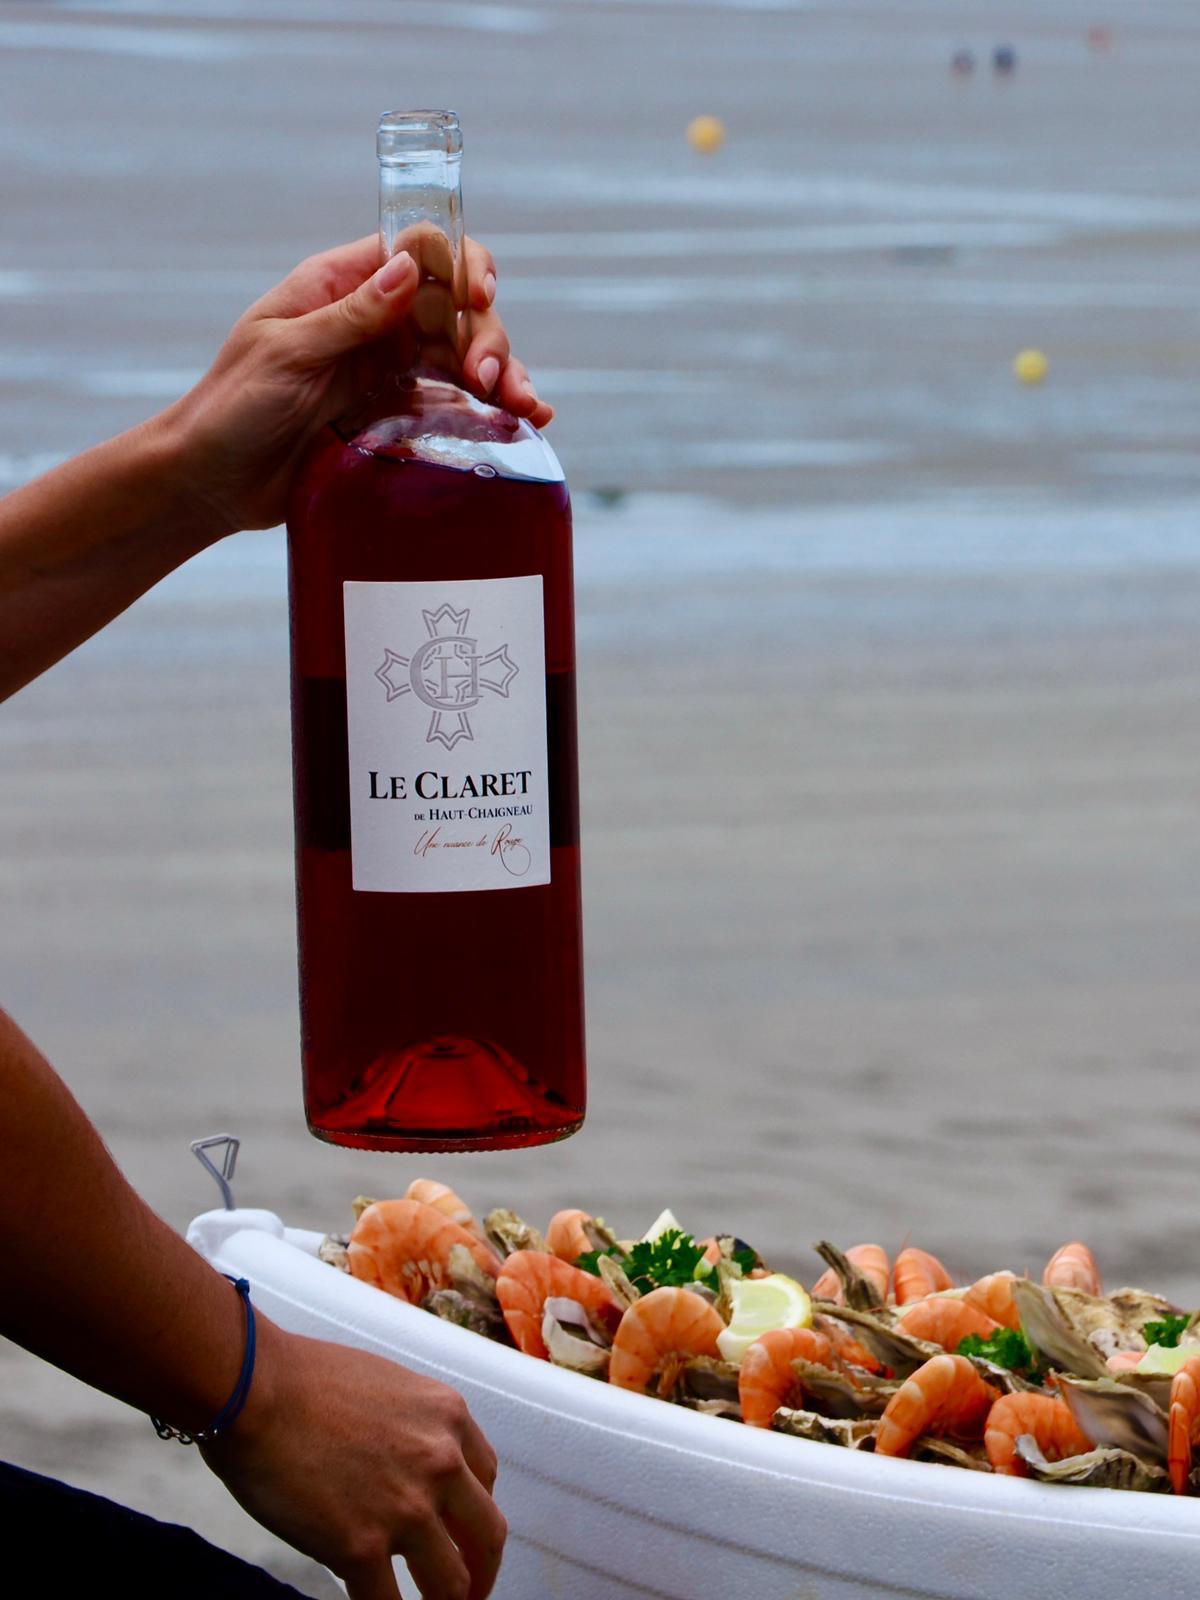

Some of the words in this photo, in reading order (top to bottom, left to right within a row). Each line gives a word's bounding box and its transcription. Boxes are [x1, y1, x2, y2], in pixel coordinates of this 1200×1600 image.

[369, 771, 407, 799] LE
[415, 771, 532, 799] CLARET
[429, 805, 533, 820] HAUT-CHAIGNEAU
[413, 826, 440, 857] Une
[475, 835, 488, 848] de
[491, 823, 532, 876] Rouge
